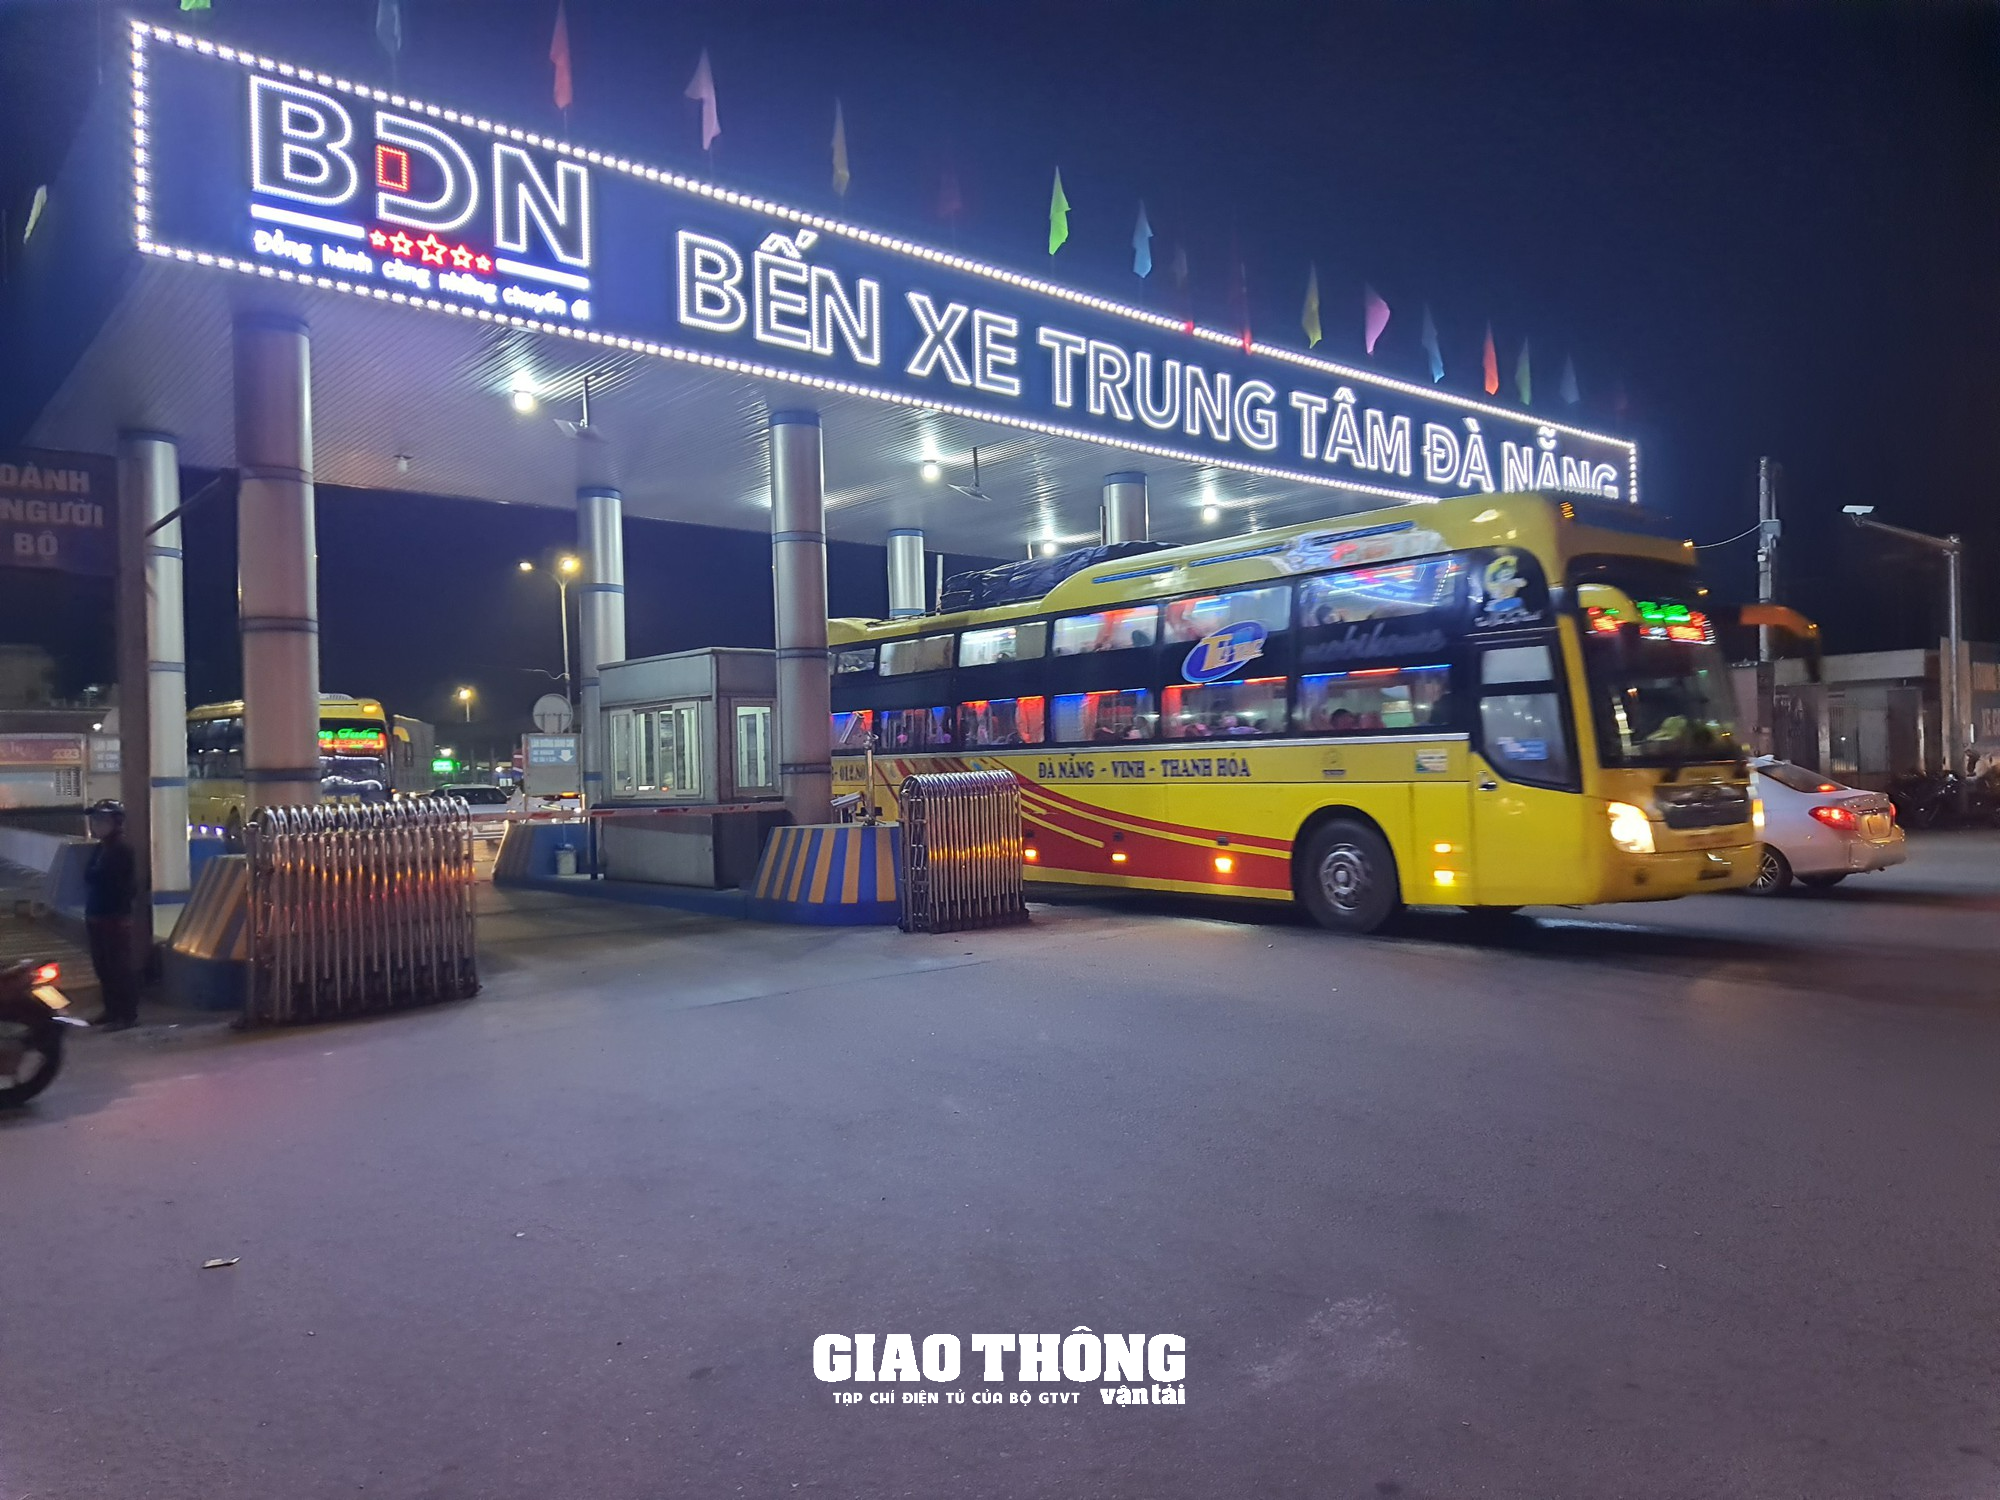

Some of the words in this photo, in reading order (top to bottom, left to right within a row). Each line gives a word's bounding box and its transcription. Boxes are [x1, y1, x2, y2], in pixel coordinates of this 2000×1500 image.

[250, 74, 591, 267] BDN
[676, 228, 882, 367] BẾN
[905, 290, 1021, 397] XE
[1037, 325, 1278, 452] TRUNG
[1289, 386, 1411, 477] TÂM
[1422, 416, 1496, 494] ĐÀ
[1502, 427, 1619, 499] NẴNG
[1038, 757, 1055, 778] ĐÀ
[1112, 760, 1145, 778] VINH
[1161, 758, 1212, 777] THANH
